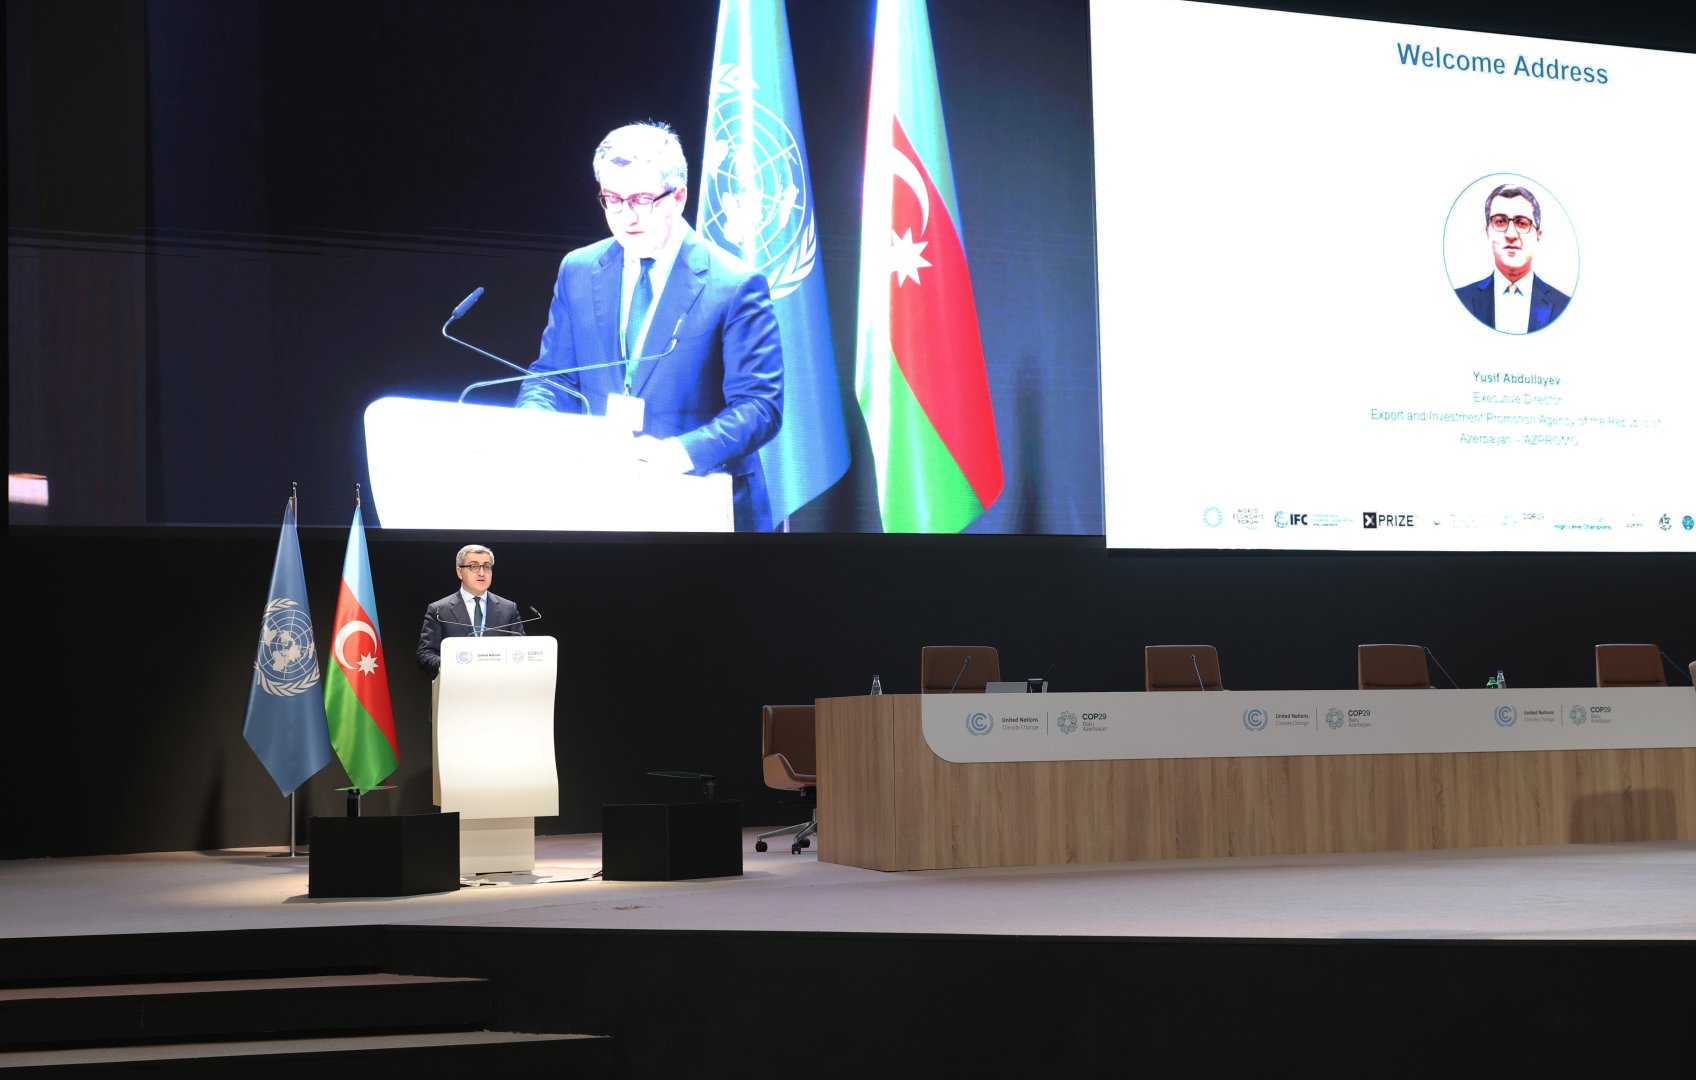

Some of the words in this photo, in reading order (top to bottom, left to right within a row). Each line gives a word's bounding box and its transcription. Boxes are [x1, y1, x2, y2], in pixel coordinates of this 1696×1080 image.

[1397, 42, 1505, 75] Welcome
[1514, 55, 1609, 84] Address
[1473, 371, 1500, 383] Yusif
[1503, 373, 1560, 388] Abdullayev
[1371, 408, 1404, 423] Export
[1407, 411, 1426, 421] and
[1429, 411, 1483, 423] Investment
[1290, 513, 1308, 526] IFC
[1348, 709, 1371, 717] COP29
